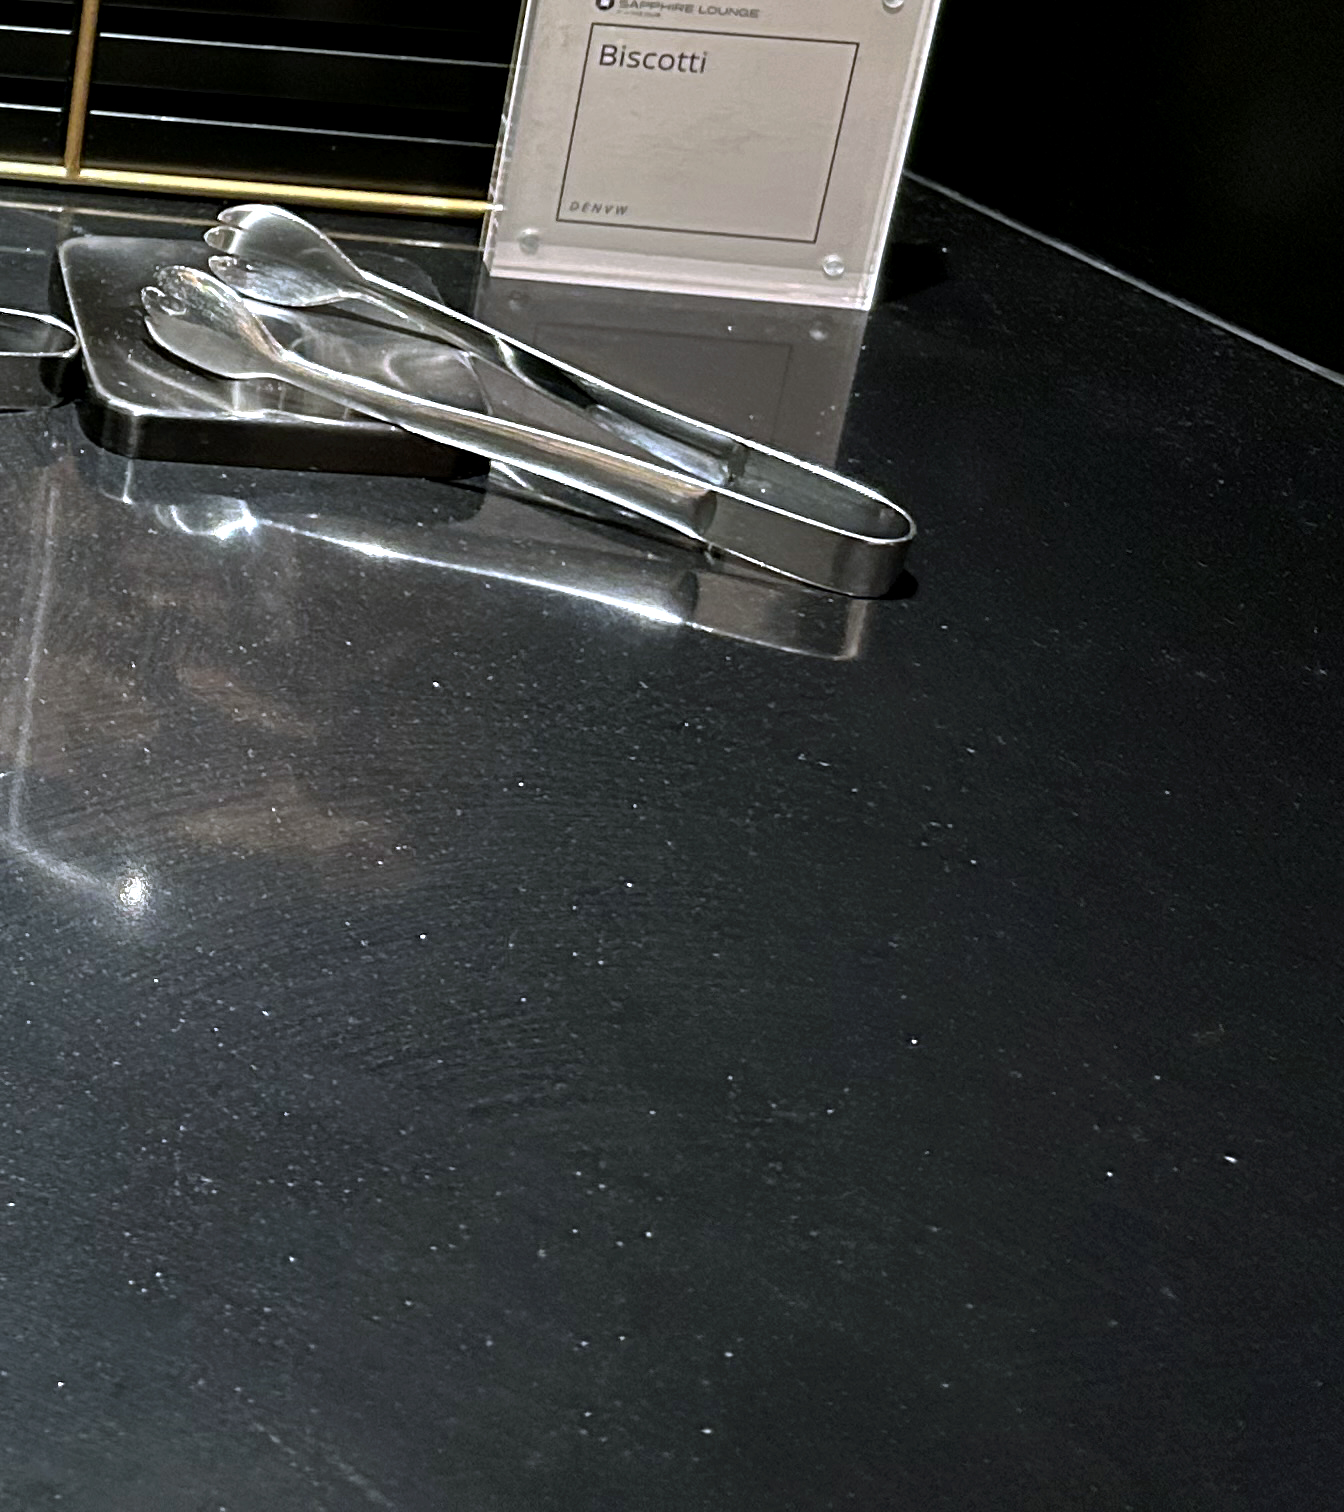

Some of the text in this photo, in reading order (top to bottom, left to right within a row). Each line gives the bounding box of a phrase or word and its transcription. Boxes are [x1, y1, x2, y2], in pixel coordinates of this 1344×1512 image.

[618, 0, 695, 14] SAPPHIRE
[698, 5, 761, 19] LOUNGE
[599, 44, 708, 74] Biscotti
